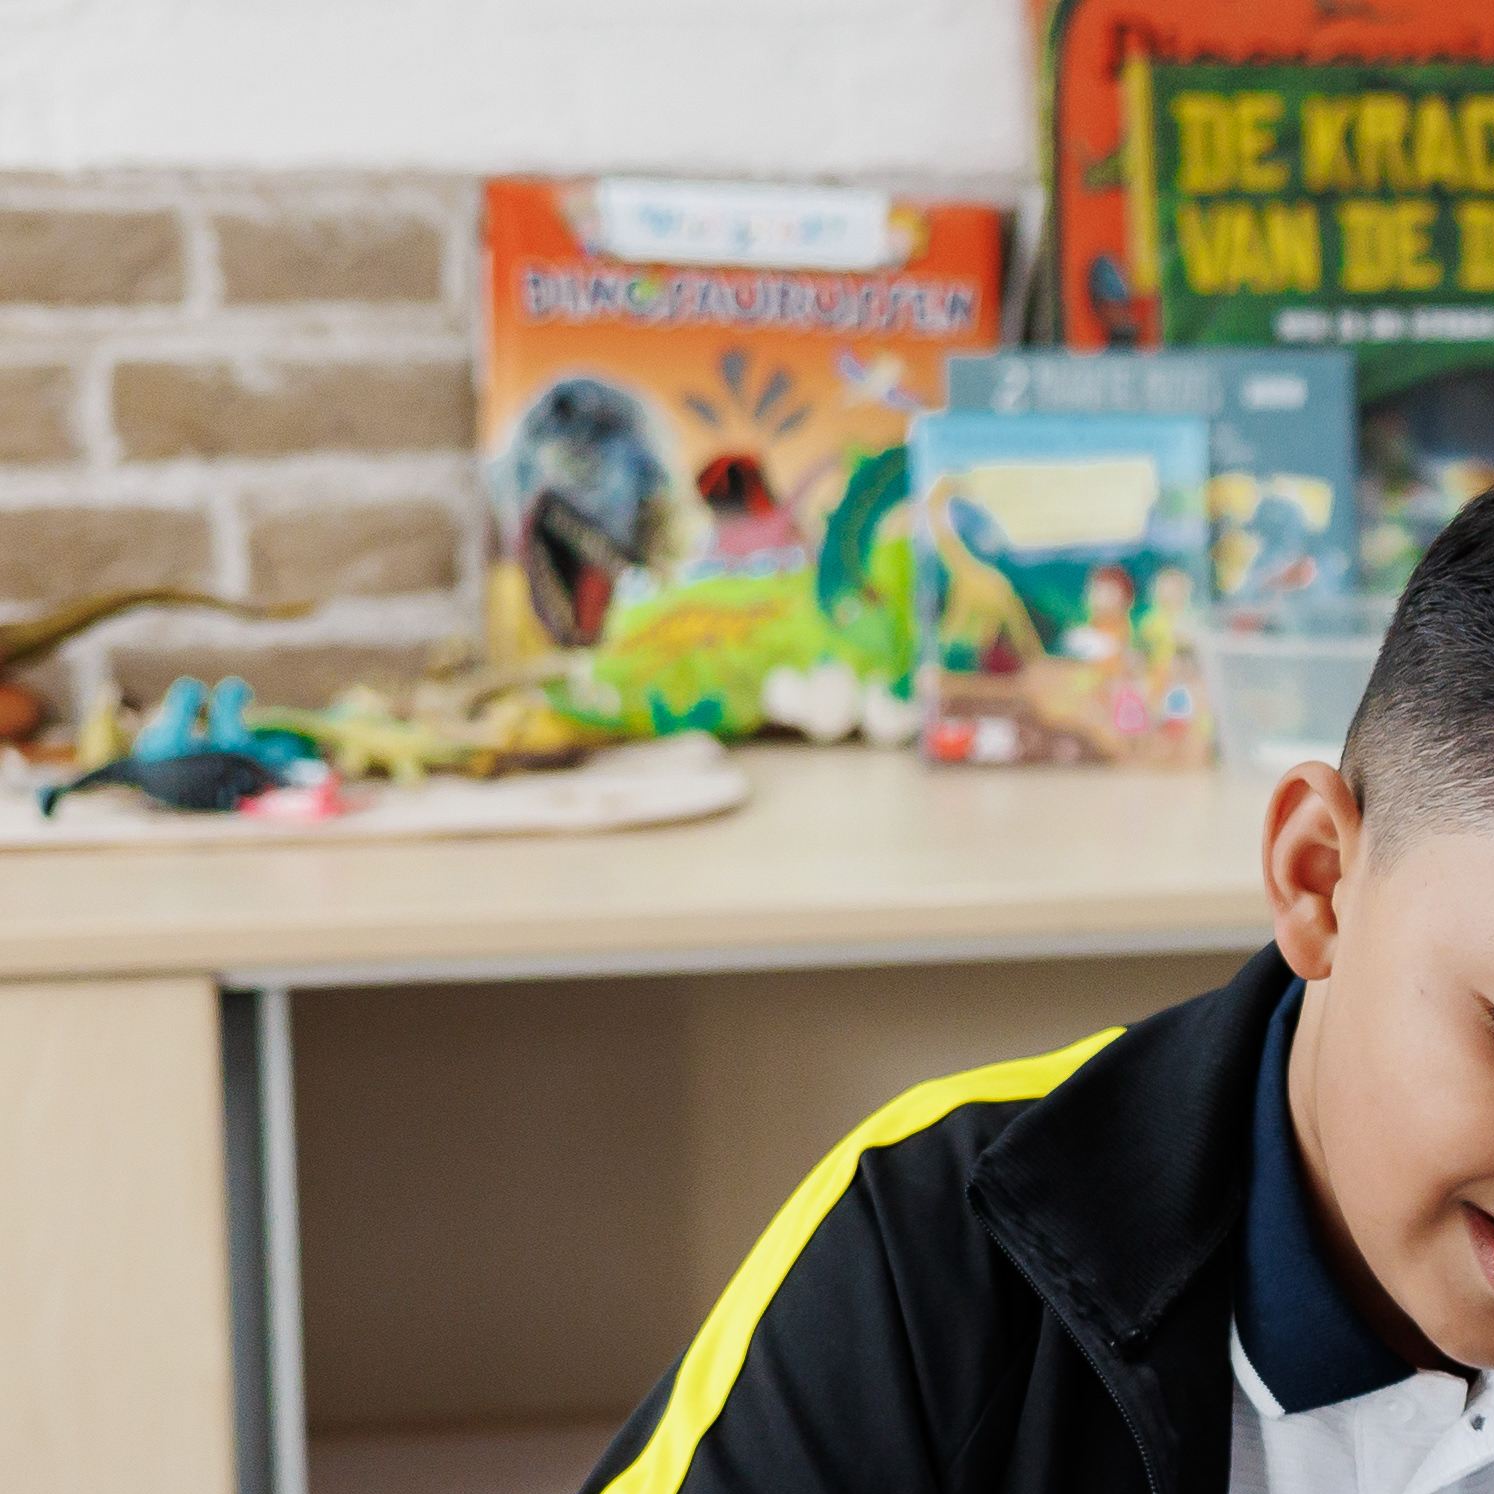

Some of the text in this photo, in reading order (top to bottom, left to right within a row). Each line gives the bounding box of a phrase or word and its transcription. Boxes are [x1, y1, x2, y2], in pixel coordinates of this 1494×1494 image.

[1170, 90, 1292, 195] DE
[1175, 203, 1322, 293] VAN
[1337, 203, 1443, 290] DE
